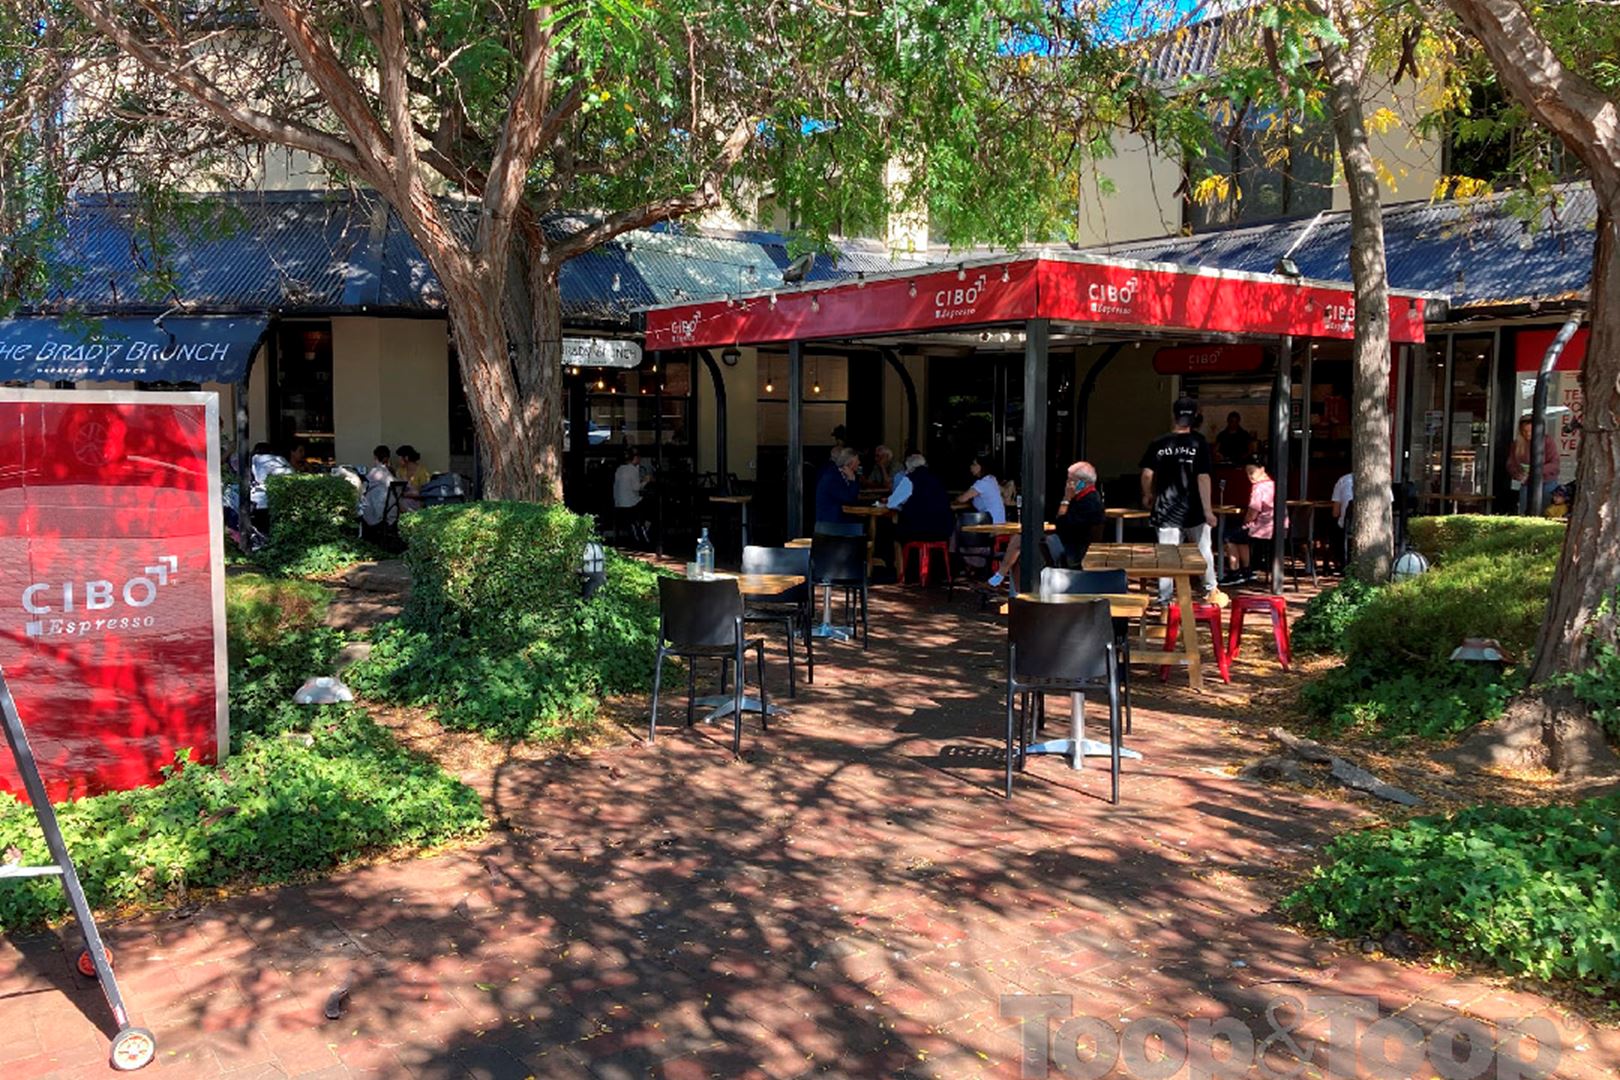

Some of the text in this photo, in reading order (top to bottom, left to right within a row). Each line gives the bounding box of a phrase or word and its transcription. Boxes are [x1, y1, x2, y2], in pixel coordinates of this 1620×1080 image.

[936, 287, 977, 307] CIBO
[1088, 283, 1132, 303] CIBO
[36, 341, 121, 365] BRADY
[125, 341, 231, 361] BRUNCH
[1188, 353, 1218, 365] CIBO
[21, 576, 158, 615] CIBO
[49, 615, 156, 635] Espresso
